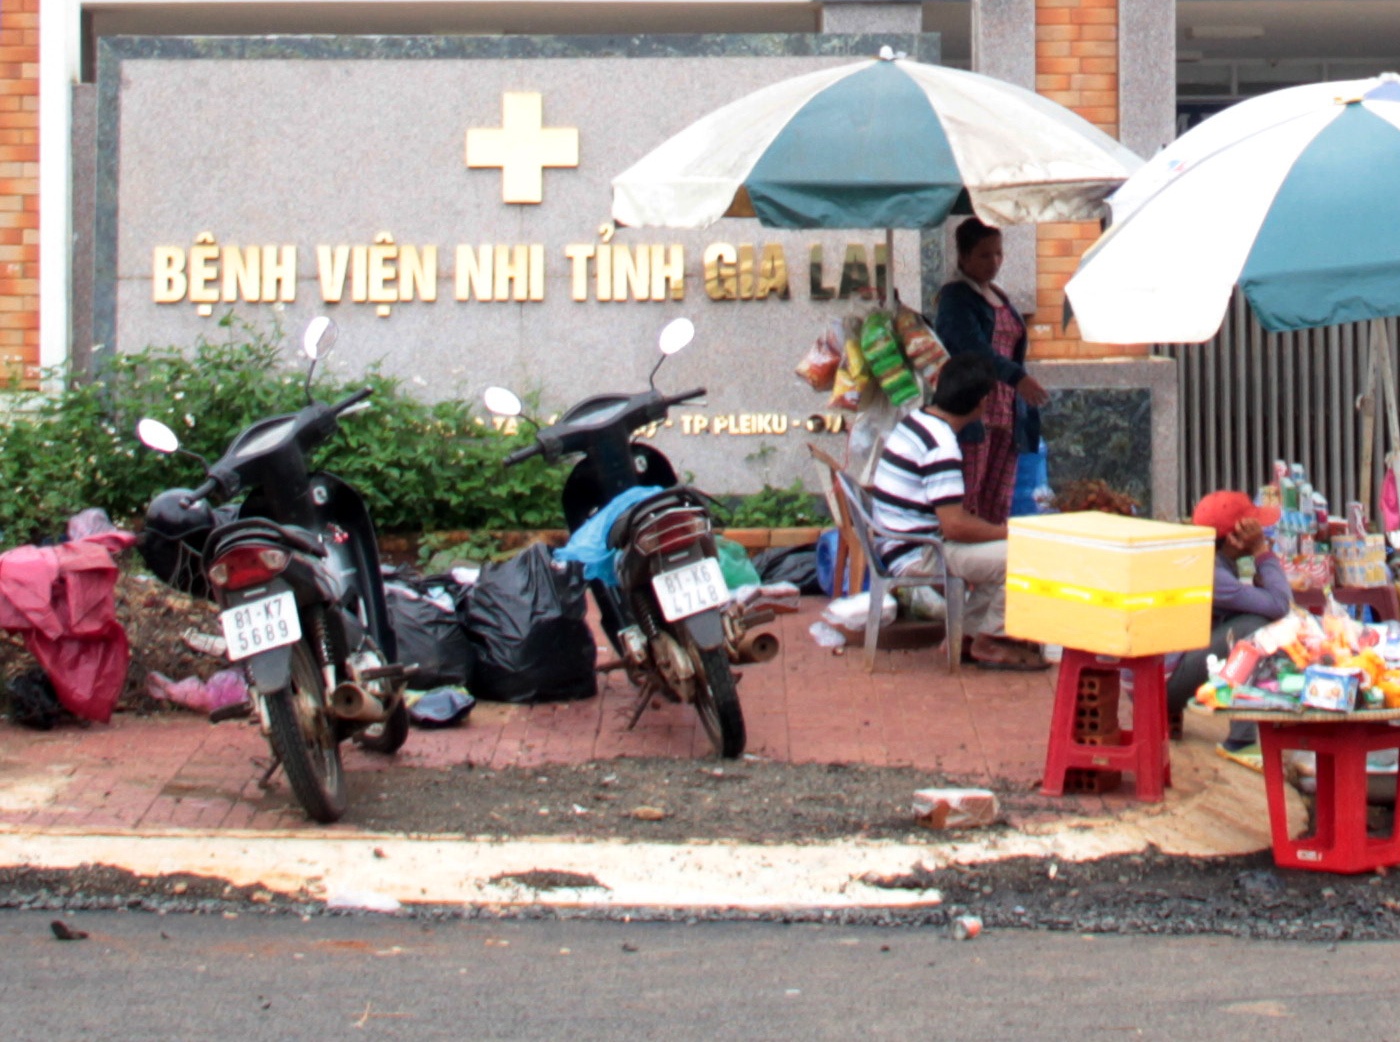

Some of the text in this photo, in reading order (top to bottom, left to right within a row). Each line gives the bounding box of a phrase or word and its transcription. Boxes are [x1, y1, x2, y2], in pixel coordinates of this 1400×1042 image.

[153, 223, 888, 317] BỆNH VIỆN NHI TỈNH GIA LAI
[713, 413, 789, 435] PLEIKU
[235, 598, 282, 629] 81-K7
[238, 619, 289, 650] 5689
